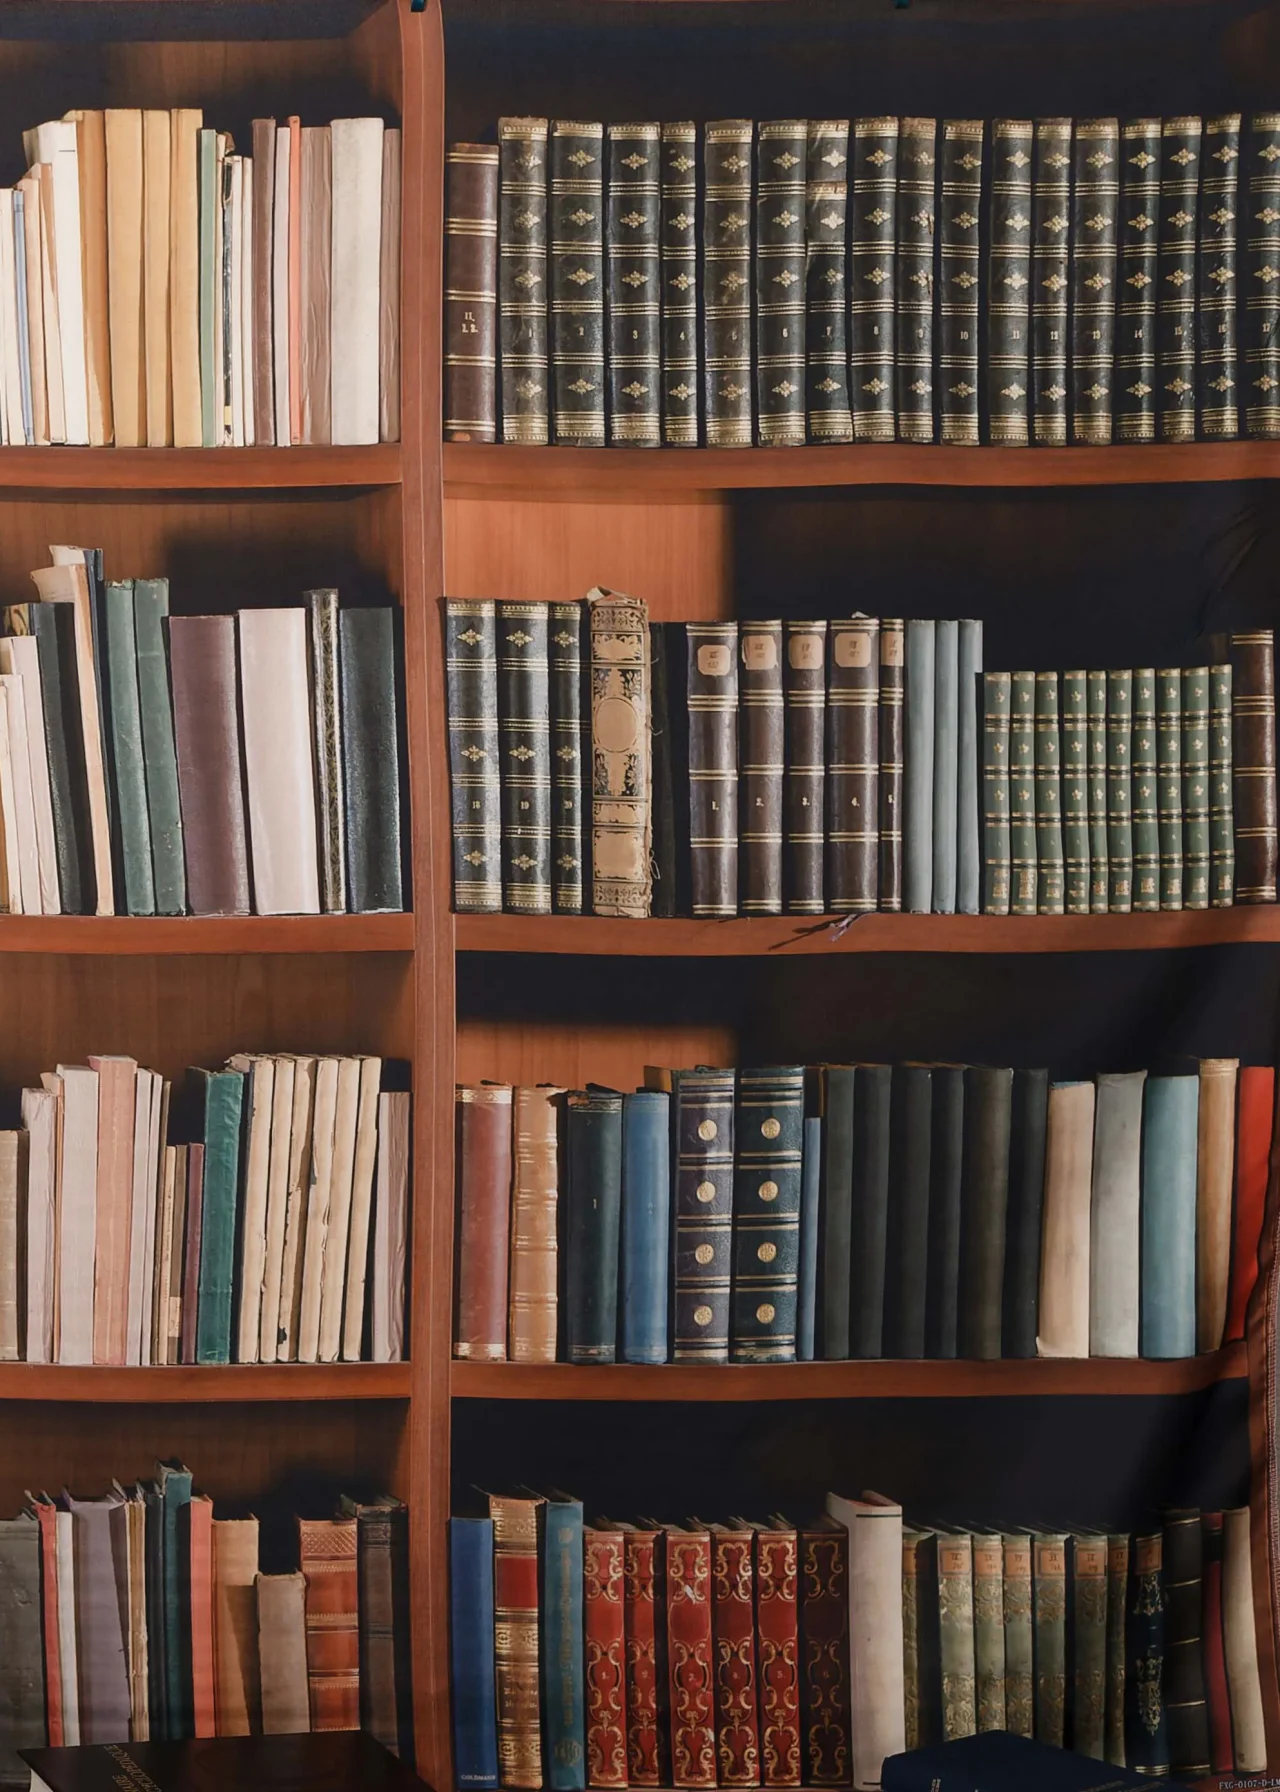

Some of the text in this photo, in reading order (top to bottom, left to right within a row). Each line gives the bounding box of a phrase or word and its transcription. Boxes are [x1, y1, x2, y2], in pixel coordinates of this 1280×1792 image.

[1174, 326, 1182, 335] 15
[1262, 322, 1271, 333] 17
[960, 331, 969, 340] 10
[1012, 330, 1020, 340] 11
[1050, 330, 1058, 340] 12
[1092, 330, 1101, 340] 13
[1134, 329, 1142, 339] 14
[472, 800, 481, 809] 18
[521, 800, 529, 810] 19
